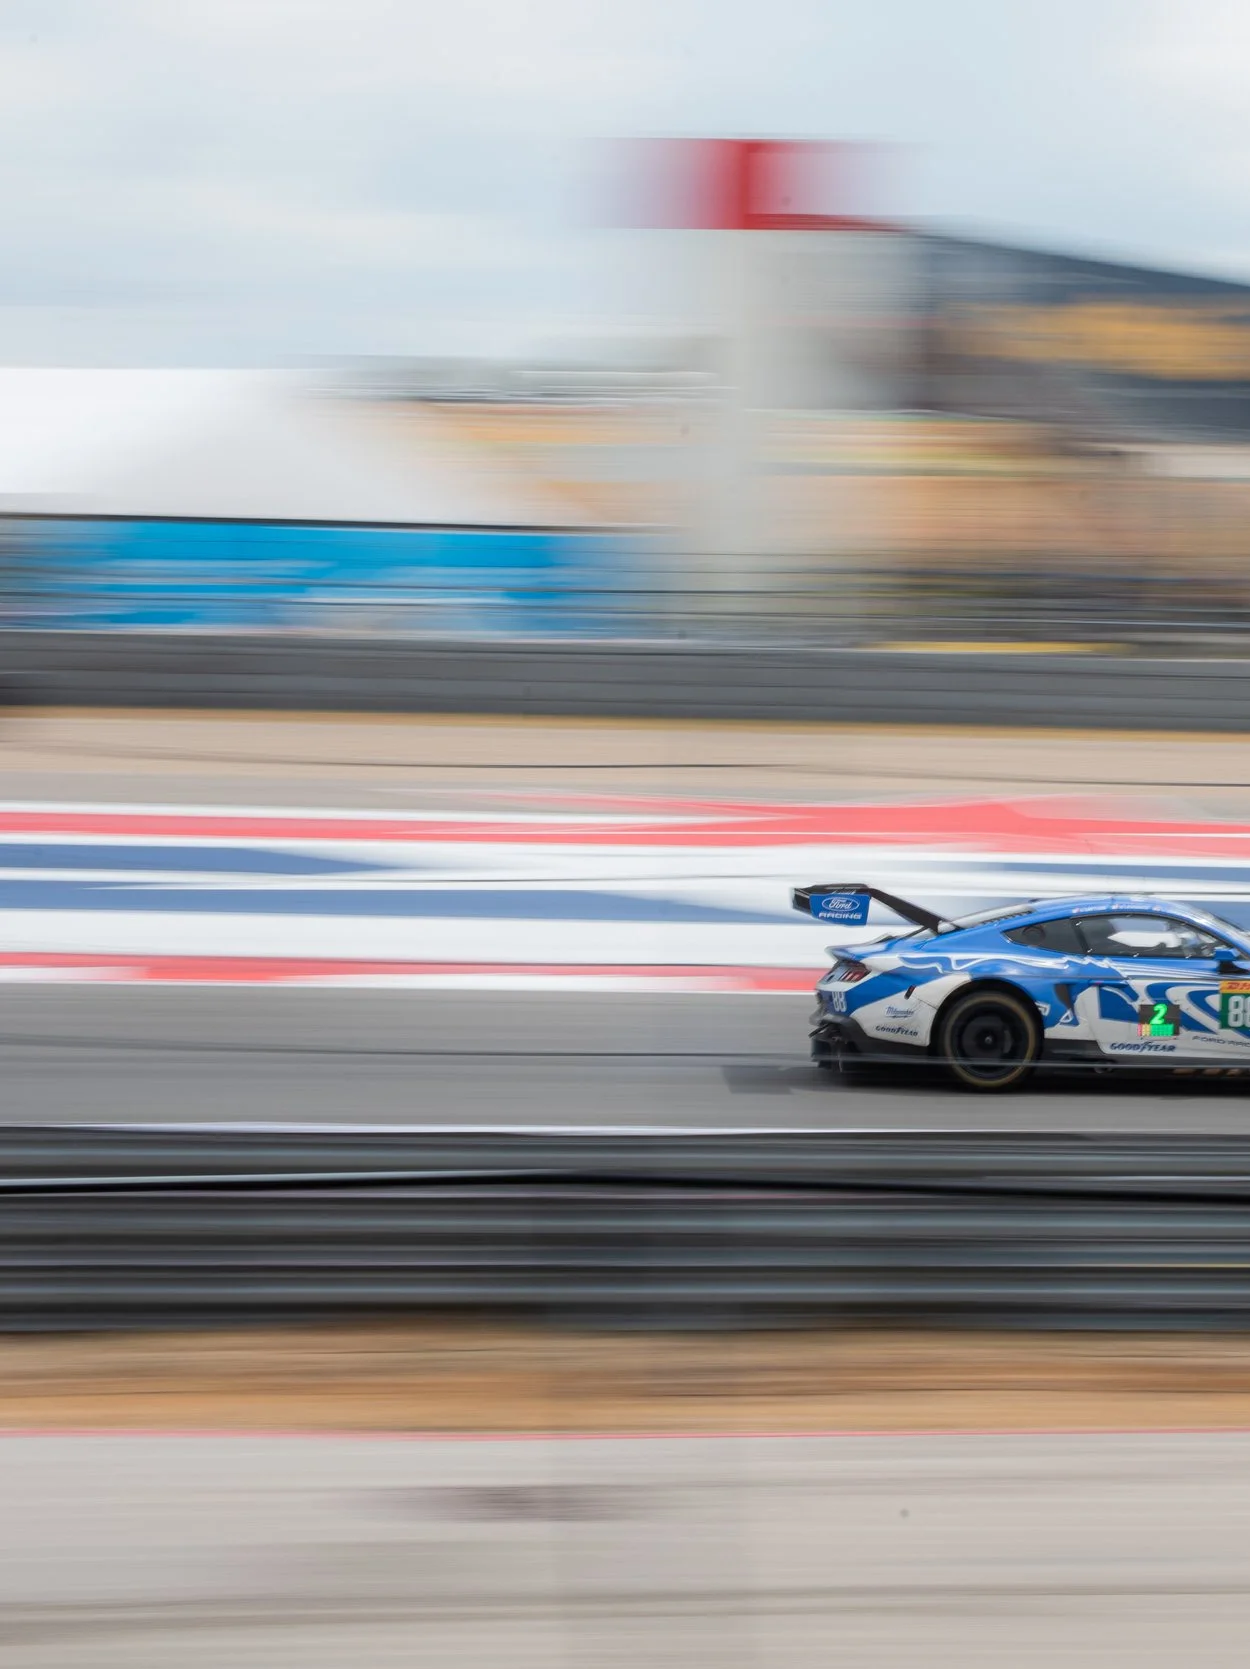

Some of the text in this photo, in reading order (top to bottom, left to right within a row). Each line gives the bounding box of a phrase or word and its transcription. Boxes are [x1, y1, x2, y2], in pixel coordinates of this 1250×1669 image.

[829, 898, 853, 909] Ford
[831, 991, 847, 1012] 88
[1150, 1003, 1168, 1025] 2
[875, 1025, 918, 1036] GOODYEAR
[1192, 1036, 1226, 1044] FORD
[1110, 1041, 1176, 1052] GOODYEAR
